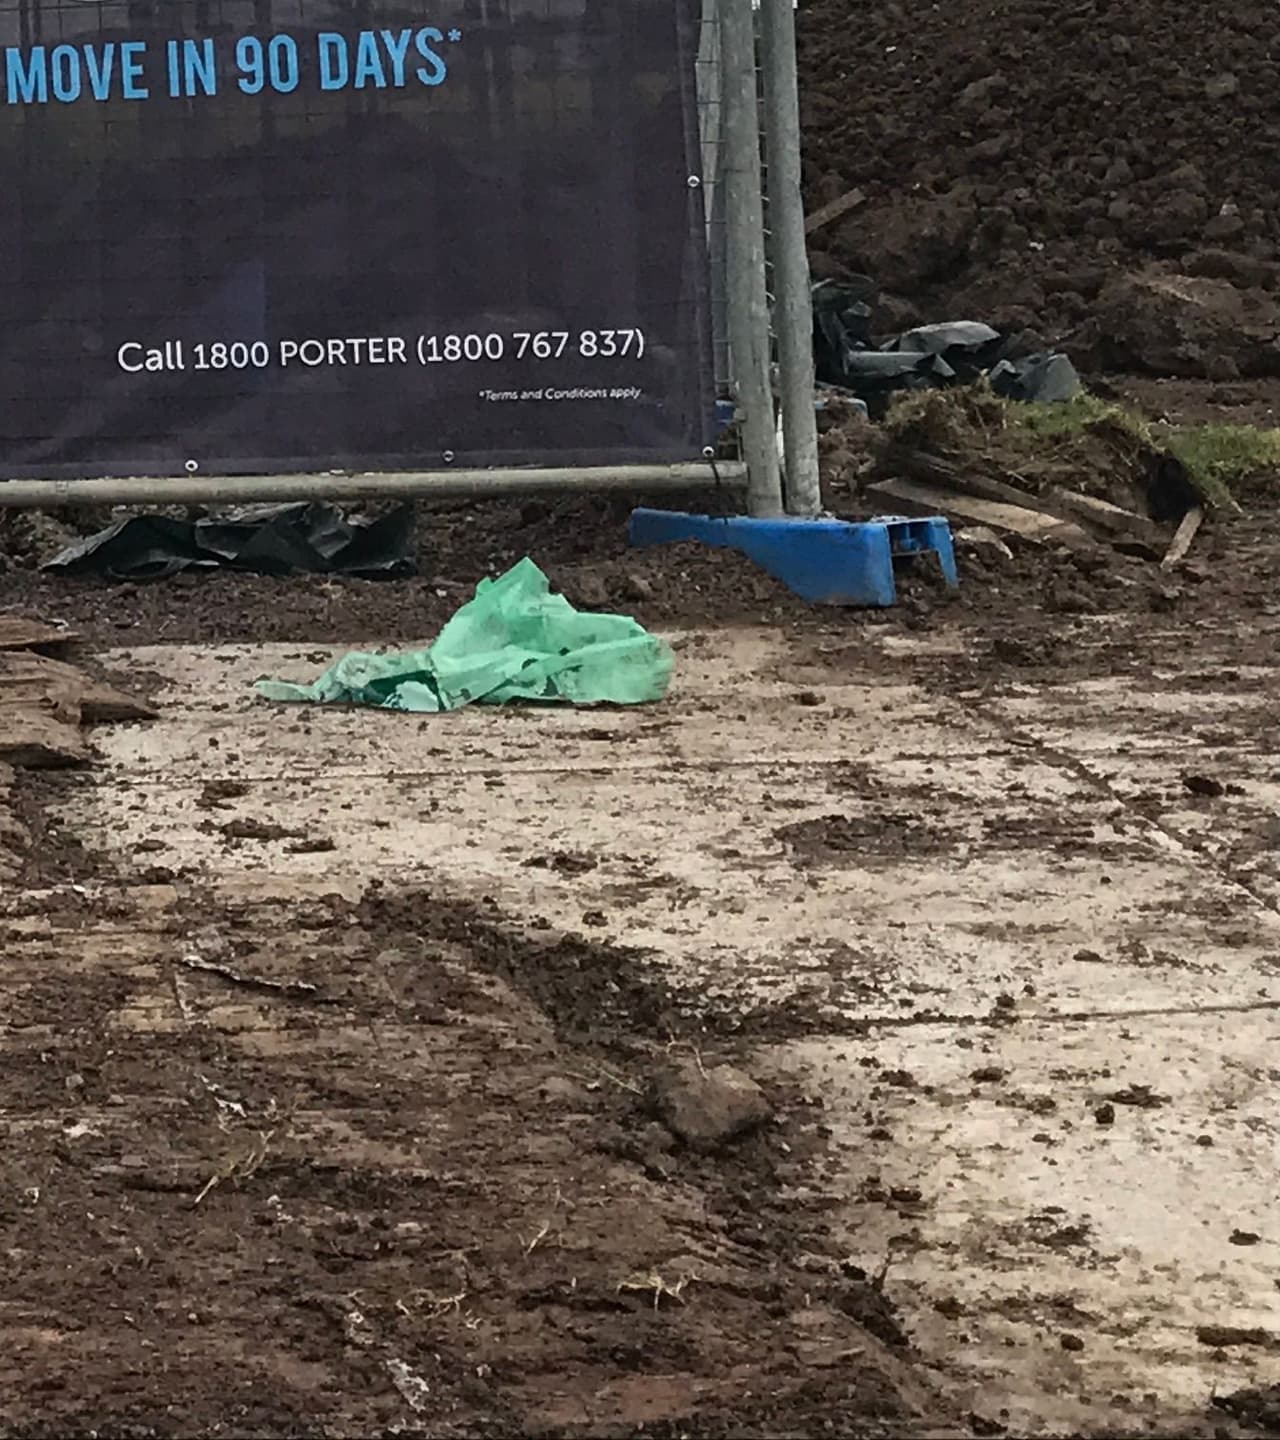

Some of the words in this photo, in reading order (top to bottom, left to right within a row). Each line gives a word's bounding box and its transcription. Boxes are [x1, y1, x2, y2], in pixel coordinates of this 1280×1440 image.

[7, 39, 149, 105] MOVE
[167, 37, 217, 98] IN
[236, 32, 301, 94] 90
[116, 340, 186, 373] Call
[193, 341, 270, 370] 1800
[280, 336, 408, 367] PORTER
[416, 331, 505, 365] (1800
[513, 330, 569, 360] 767
[578, 326, 646, 360] 837)
[520, 388, 542, 400] and
[544, 386, 607, 400] Conditions
[609, 386, 642, 400] apply
